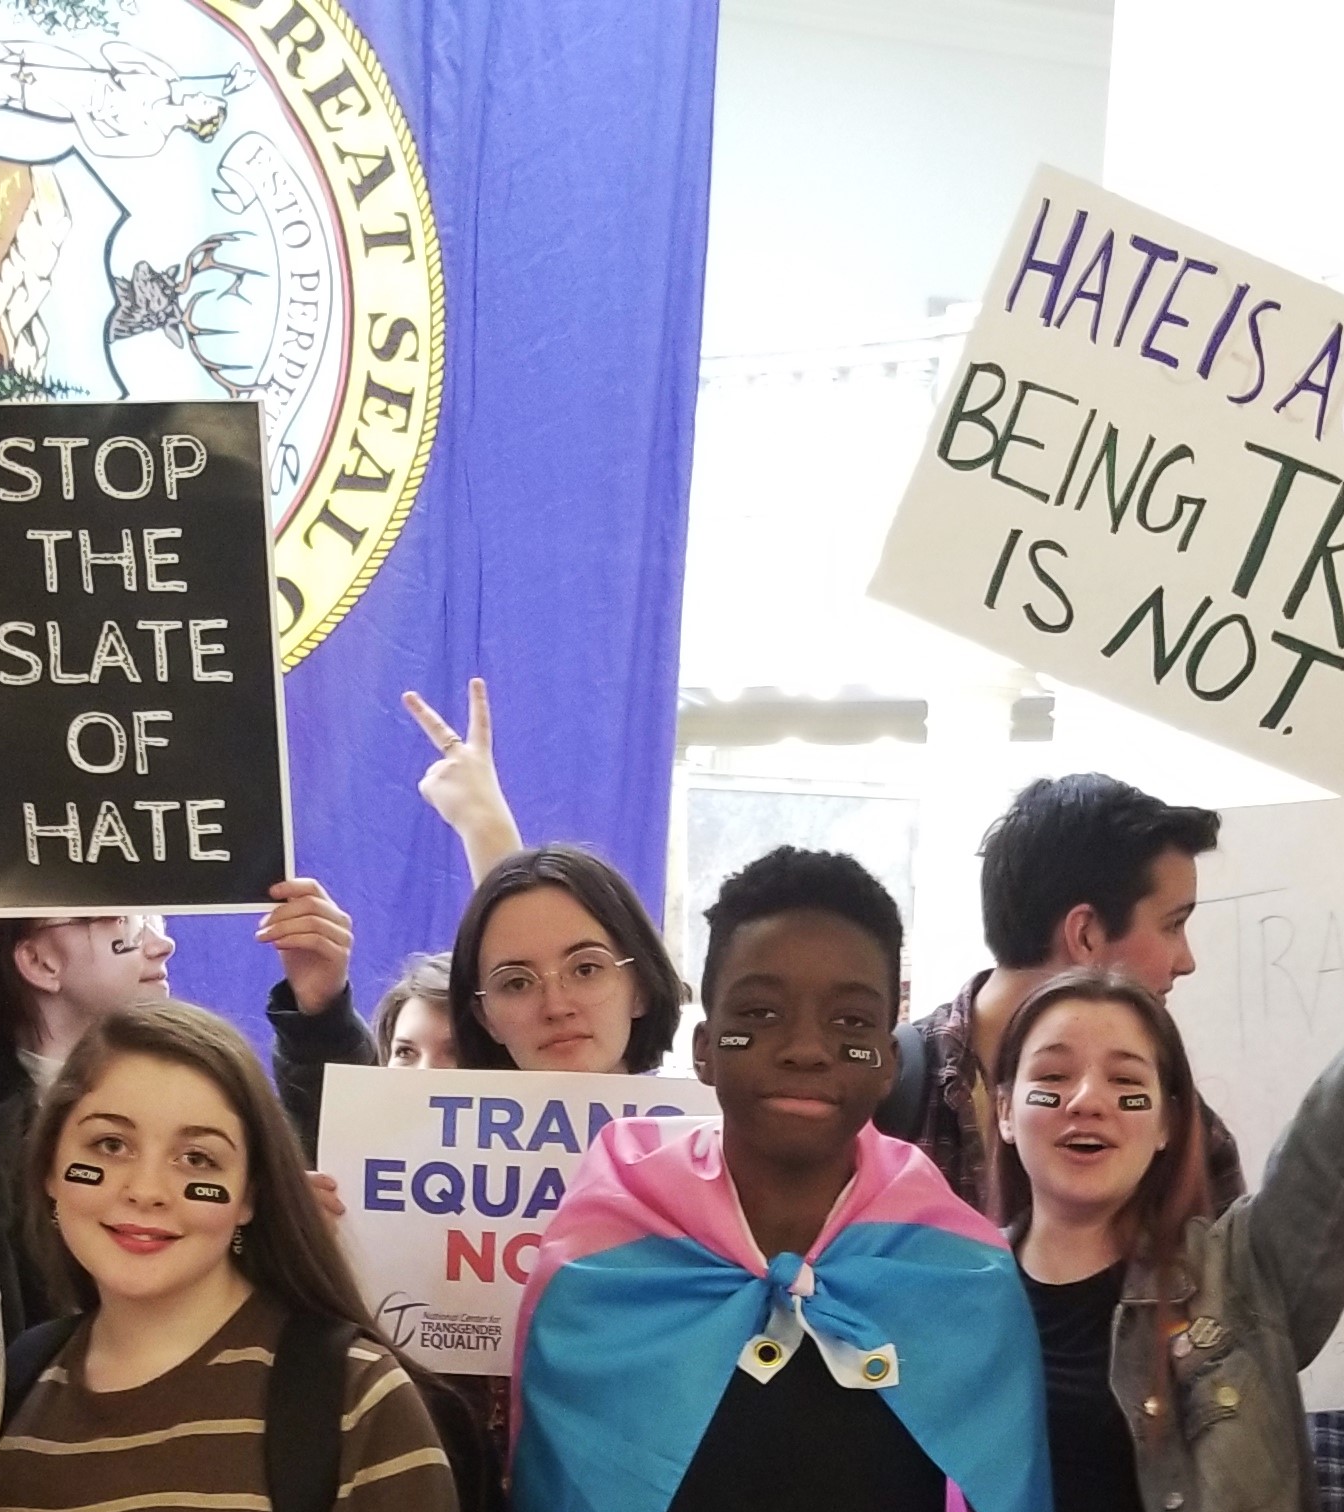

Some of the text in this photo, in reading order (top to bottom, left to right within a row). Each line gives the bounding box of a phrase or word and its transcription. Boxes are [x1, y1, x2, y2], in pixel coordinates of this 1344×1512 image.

[231, 0, 420, 556] REAT SEAL
[1006, 198, 1218, 369] HATE
[1197, 282, 1282, 405] IS
[1274, 322, 1344, 441] A
[262, 269, 320, 442] PERPE
[938, 361, 1207, 553] BEING
[25, 527, 188, 593] THE
[984, 528, 1075, 634] IS
[66, 711, 173, 775] OF
[23, 799, 231, 865] HATE
[429, 1096, 685, 1153] TRAN
[194, 1186, 221, 1198] OUT
[421, 1321, 502, 1335] TRANSGENDER
[421, 1333, 502, 1351] EQUALITY
